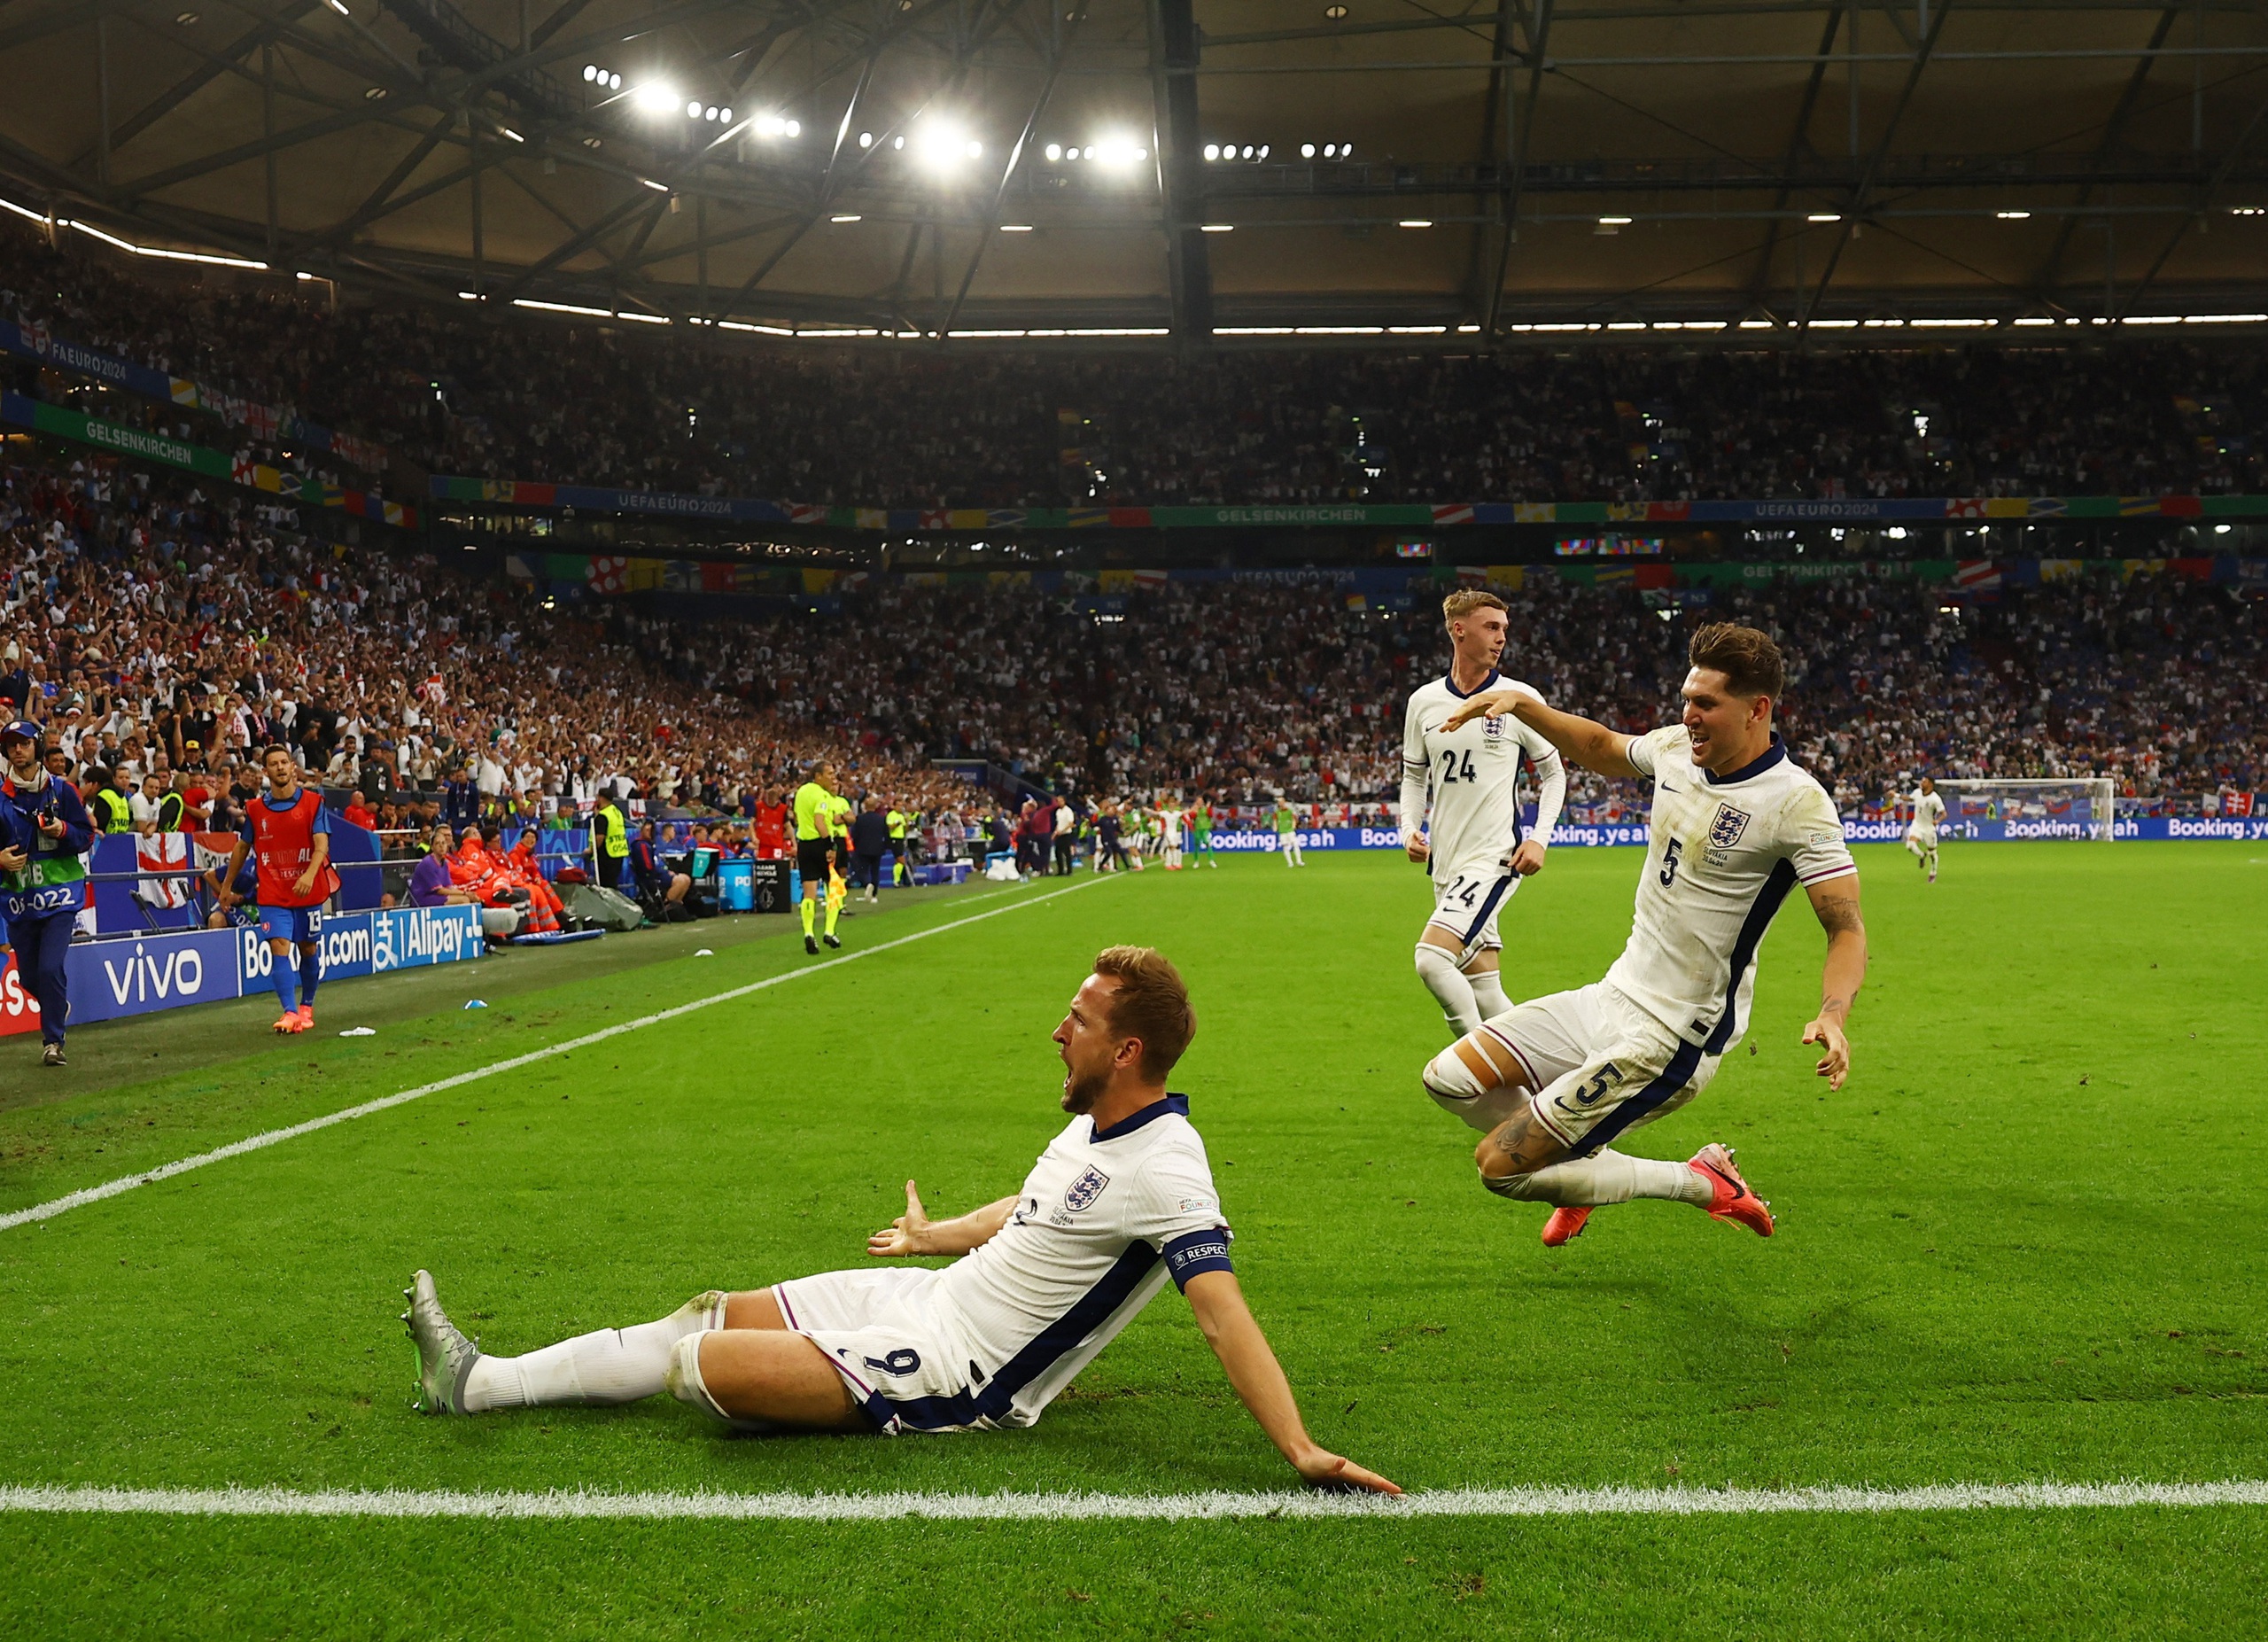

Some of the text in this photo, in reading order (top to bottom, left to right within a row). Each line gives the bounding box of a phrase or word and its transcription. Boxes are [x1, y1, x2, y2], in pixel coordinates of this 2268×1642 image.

[52, 343, 127, 379] FAEURO2024
[87, 421, 192, 464] GELSENKIRCHEN
[1216, 510, 1367, 522] GELSENKIRCHEN
[1443, 749, 1478, 783] 24
[2004, 819, 2140, 840] Booking.yah
[1659, 837, 1683, 889] 5
[1444, 875, 1481, 908] 24
[104, 942, 203, 1006] vivo
[1576, 1062, 1624, 1107] 5
